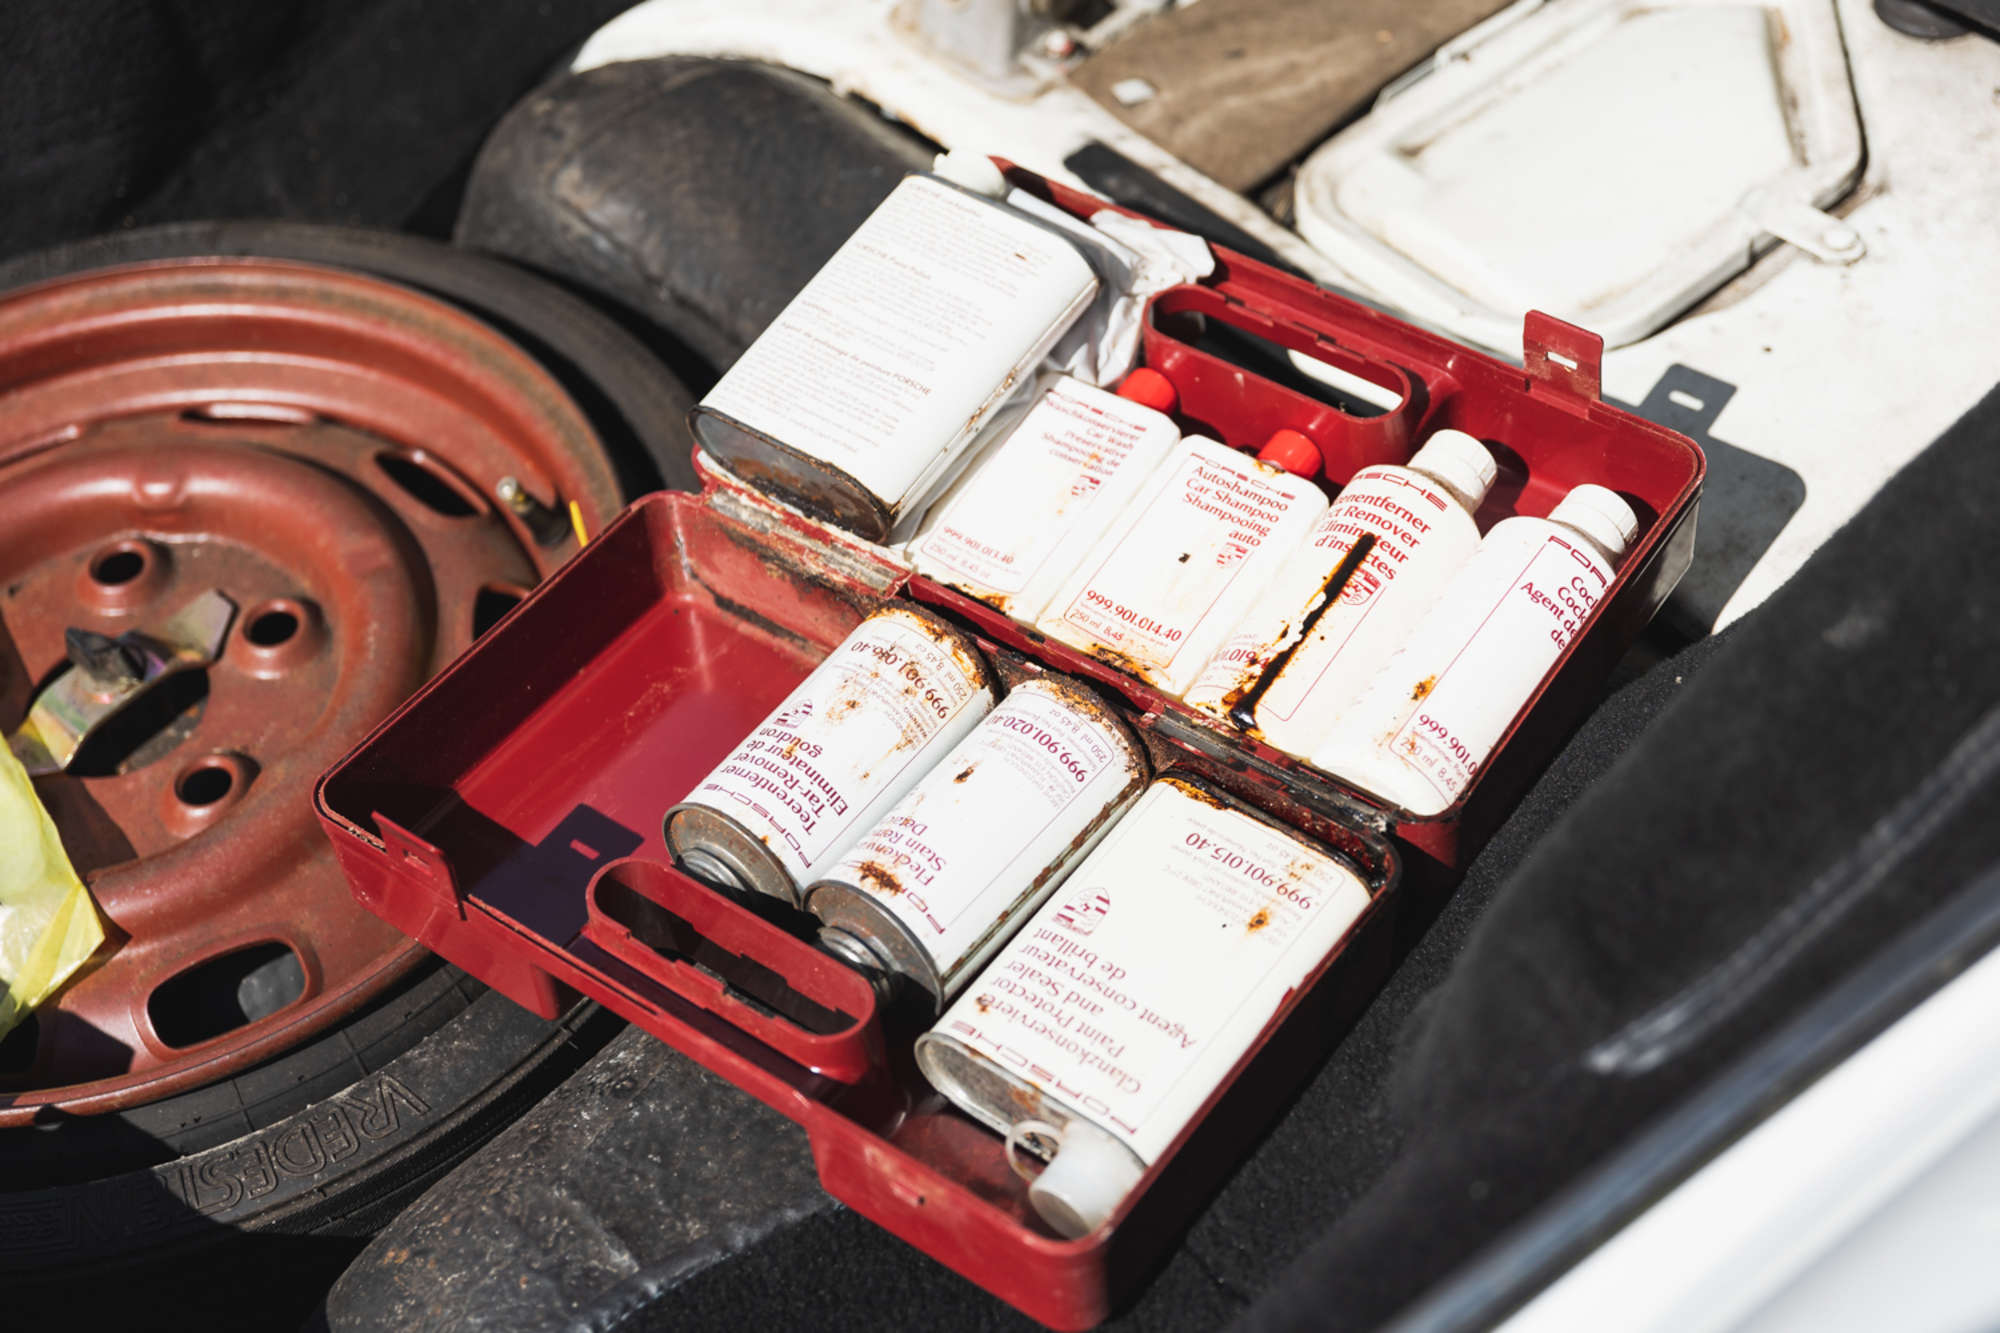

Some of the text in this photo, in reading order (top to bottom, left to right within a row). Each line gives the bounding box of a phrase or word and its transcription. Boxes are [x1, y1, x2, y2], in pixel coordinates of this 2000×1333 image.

[1186, 479, 1279, 522] Car Shampoo
[1194, 466, 1288, 511] Autoshampoo
[1184, 493, 1270, 537] Shampooing
[1229, 531, 1261, 546] auto
[1344, 506, 1420, 547] Remover
[1313, 530, 1400, 582] d'insctes
[1087, 590, 1182, 641] 999.901.014.40
[1521, 582, 1564, 620] Agent
[848, 633, 952, 721] 999.901.06.40
[759, 720, 823, 758] goudron
[720, 758, 816, 835] Teerentferner
[733, 753, 825, 818] Tar-Remover
[746, 740, 848, 815] Eliminateur de
[701, 777, 814, 870] PORSCHE
[905, 838, 946, 871] Stain
[1186, 833, 1310, 909] 999.901.015.40
[1033, 928, 1126, 980] de brillant
[1006, 961, 1104, 1014] and Sealer
[1020, 945, 1196, 1048] Agent conservateur
[992, 977, 1125, 1058] Paint Protector
